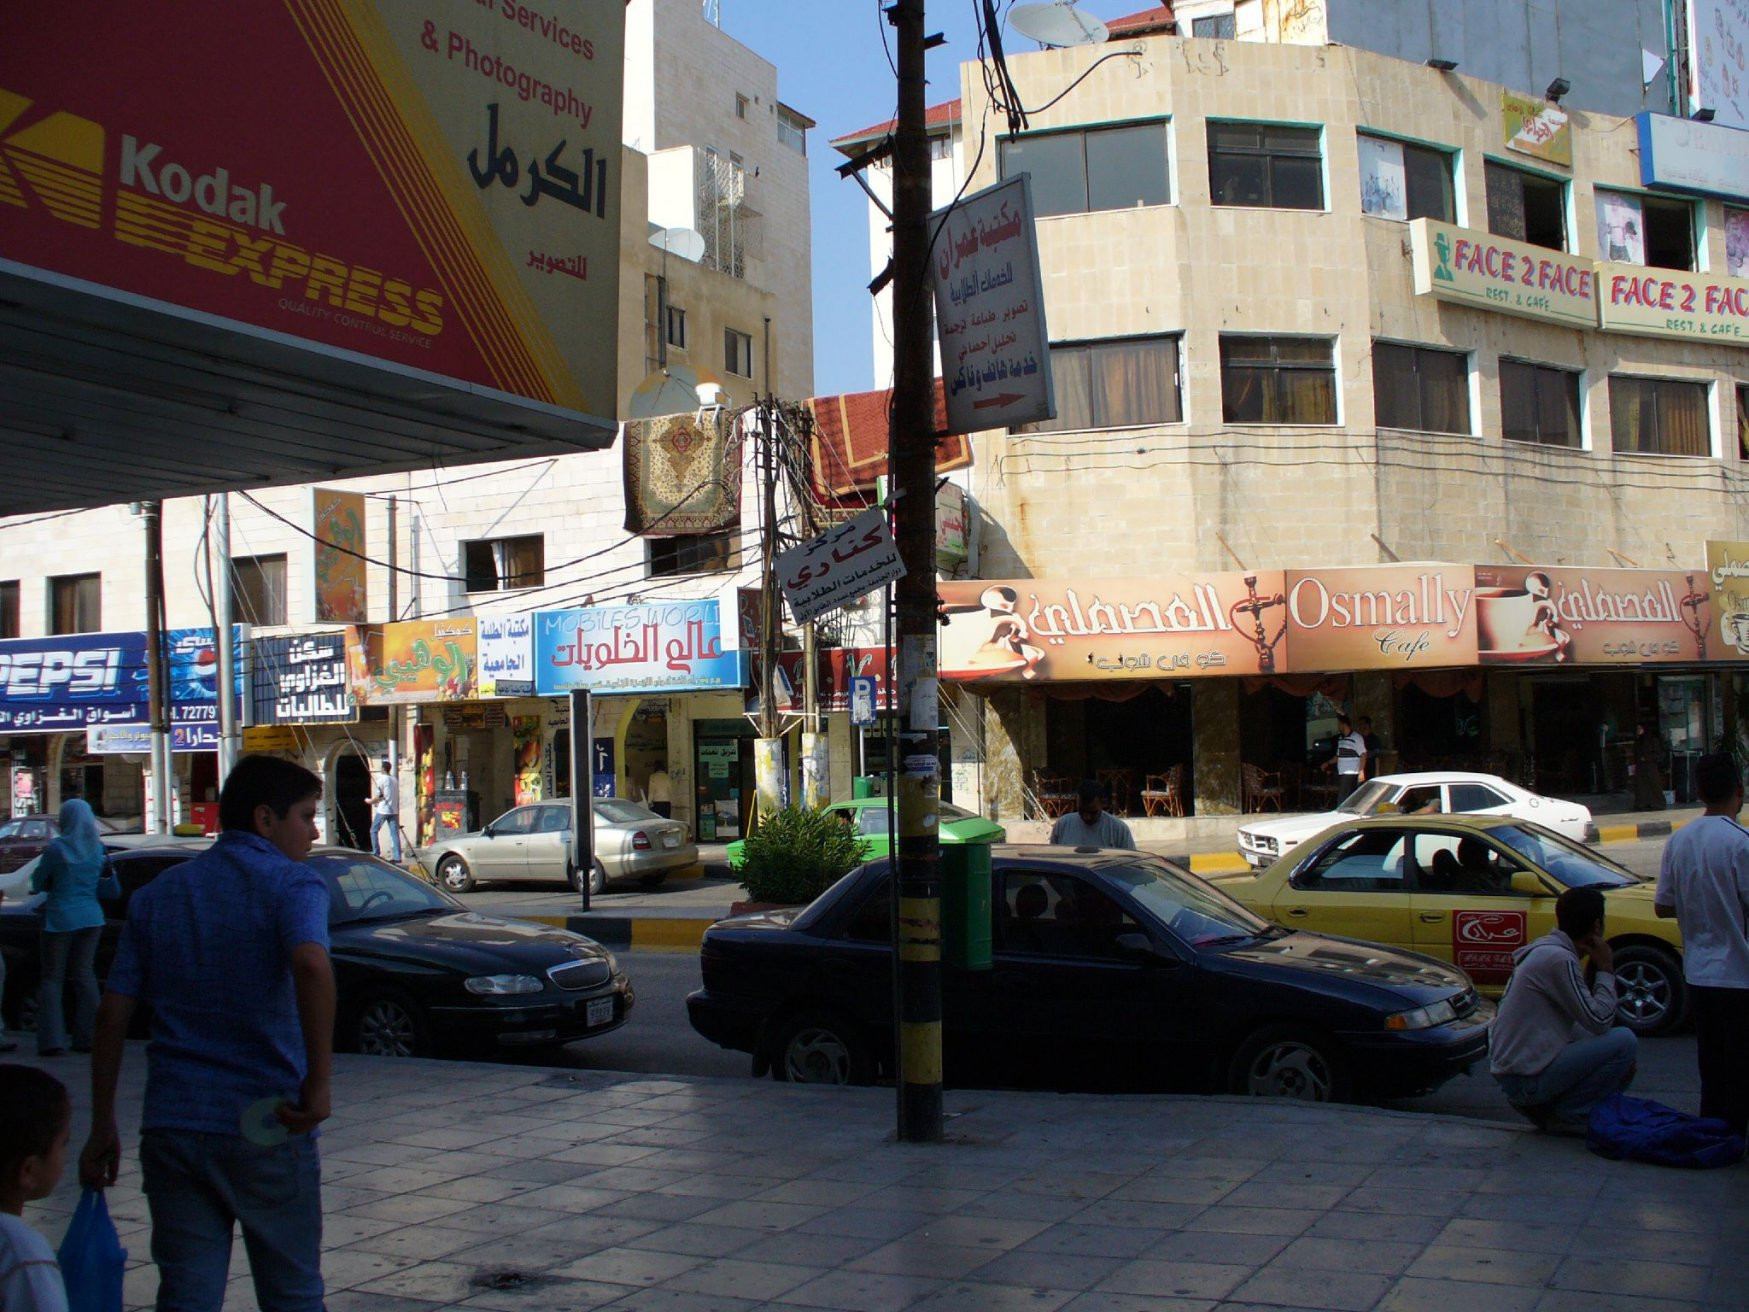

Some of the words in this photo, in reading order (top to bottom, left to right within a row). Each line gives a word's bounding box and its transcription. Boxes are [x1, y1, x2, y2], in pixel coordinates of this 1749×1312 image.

[501, 0, 594, 60] Services
[421, 20, 439, 53] &
[448, 31, 593, 129] Photography
[467, 103, 607, 219] الكرمل
[119, 134, 287, 236] Kodak
[980, 200, 1021, 253] مكتبة
[150, 205, 443, 336] EXPRESS
[526, 250, 587, 280] للتصوير
[1454, 239, 1516, 283] FACE
[1521, 255, 1536, 289] 2
[1538, 259, 1592, 299] FACE
[1611, 275, 1677, 312] FACE
[1680, 284, 1697, 313] 2
[1705, 285, 1749, 317] FAC
[278, 298, 331, 320] QUALITY
[334, 313, 387, 338] CONTROL
[389, 329, 432, 349] SERVICE
[787, 523, 882, 590] كناري
[804, 525, 856, 557] مركز
[843, 552, 897, 585] للخدمات
[647, 603, 721, 628] WORL
[1289, 573, 1473, 638] Osmally
[506, 618, 529, 645] مكتبة
[551, 622, 659, 671] الخلويات
[666, 620, 726, 675] عالم
[1374, 627, 1431, 661] Cafe
[289, 640, 334, 664] سكن
[280, 663, 345, 692] الغزاوي
[855, 680, 871, 697] P
[13, 708, 84, 727] الغزاوي
[86, 704, 137, 723] أسواق
[276, 694, 350, 722] للطالبات
[174, 728, 185, 746] 2
